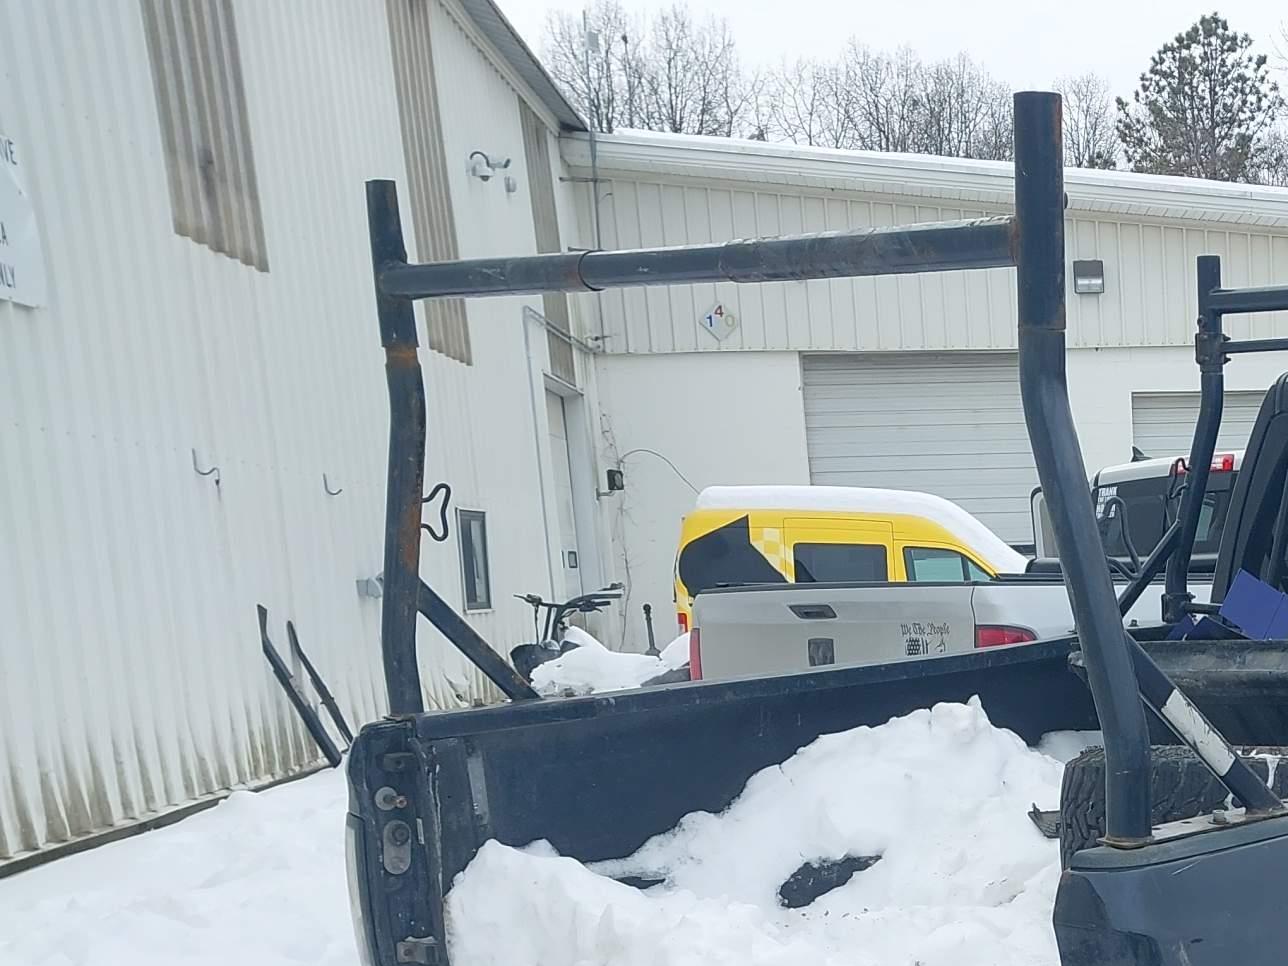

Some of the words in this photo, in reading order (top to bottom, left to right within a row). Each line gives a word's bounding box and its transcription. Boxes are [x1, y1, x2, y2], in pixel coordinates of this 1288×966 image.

[714, 304, 724, 318] 4
[706, 314, 713, 327] 1
[724, 314, 735, 327] 0
[912, 622, 926, 636] The
[927, 621, 951, 637] People
